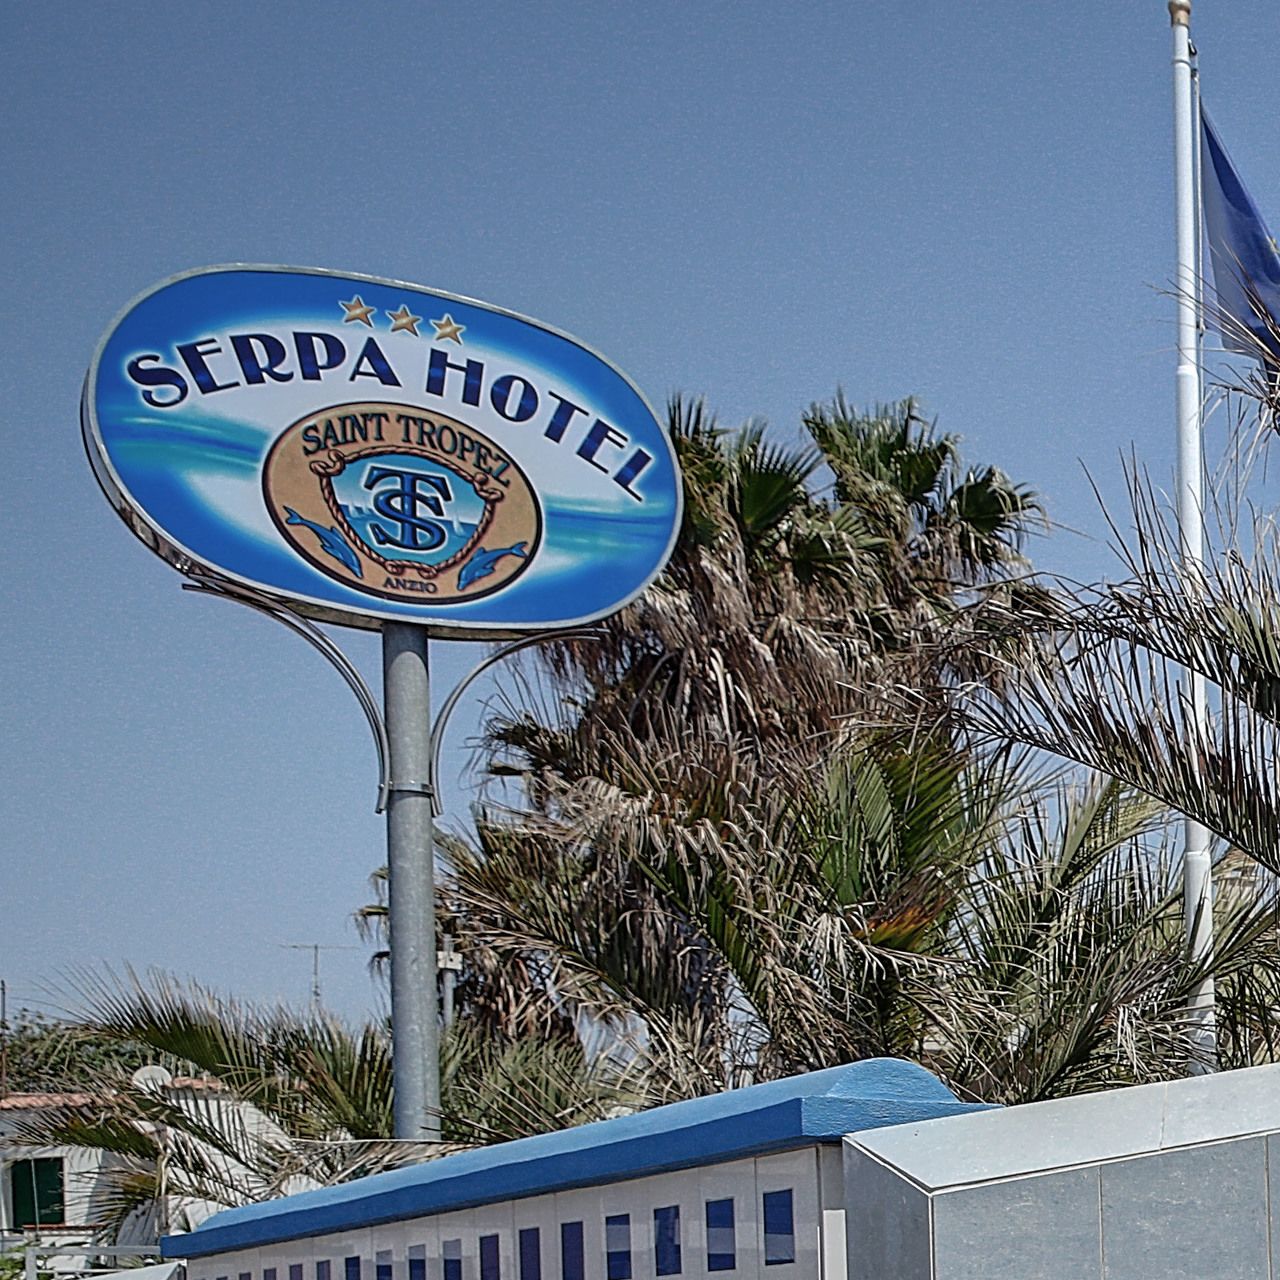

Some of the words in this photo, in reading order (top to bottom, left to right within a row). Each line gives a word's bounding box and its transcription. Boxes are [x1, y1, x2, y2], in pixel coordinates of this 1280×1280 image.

[126, 331, 403, 408] SERPA
[425, 347, 654, 503] HOTEL
[301, 412, 390, 457] SAINT
[396, 413, 511, 488] TROPEZ
[382, 576, 438, 594] ANZIO
